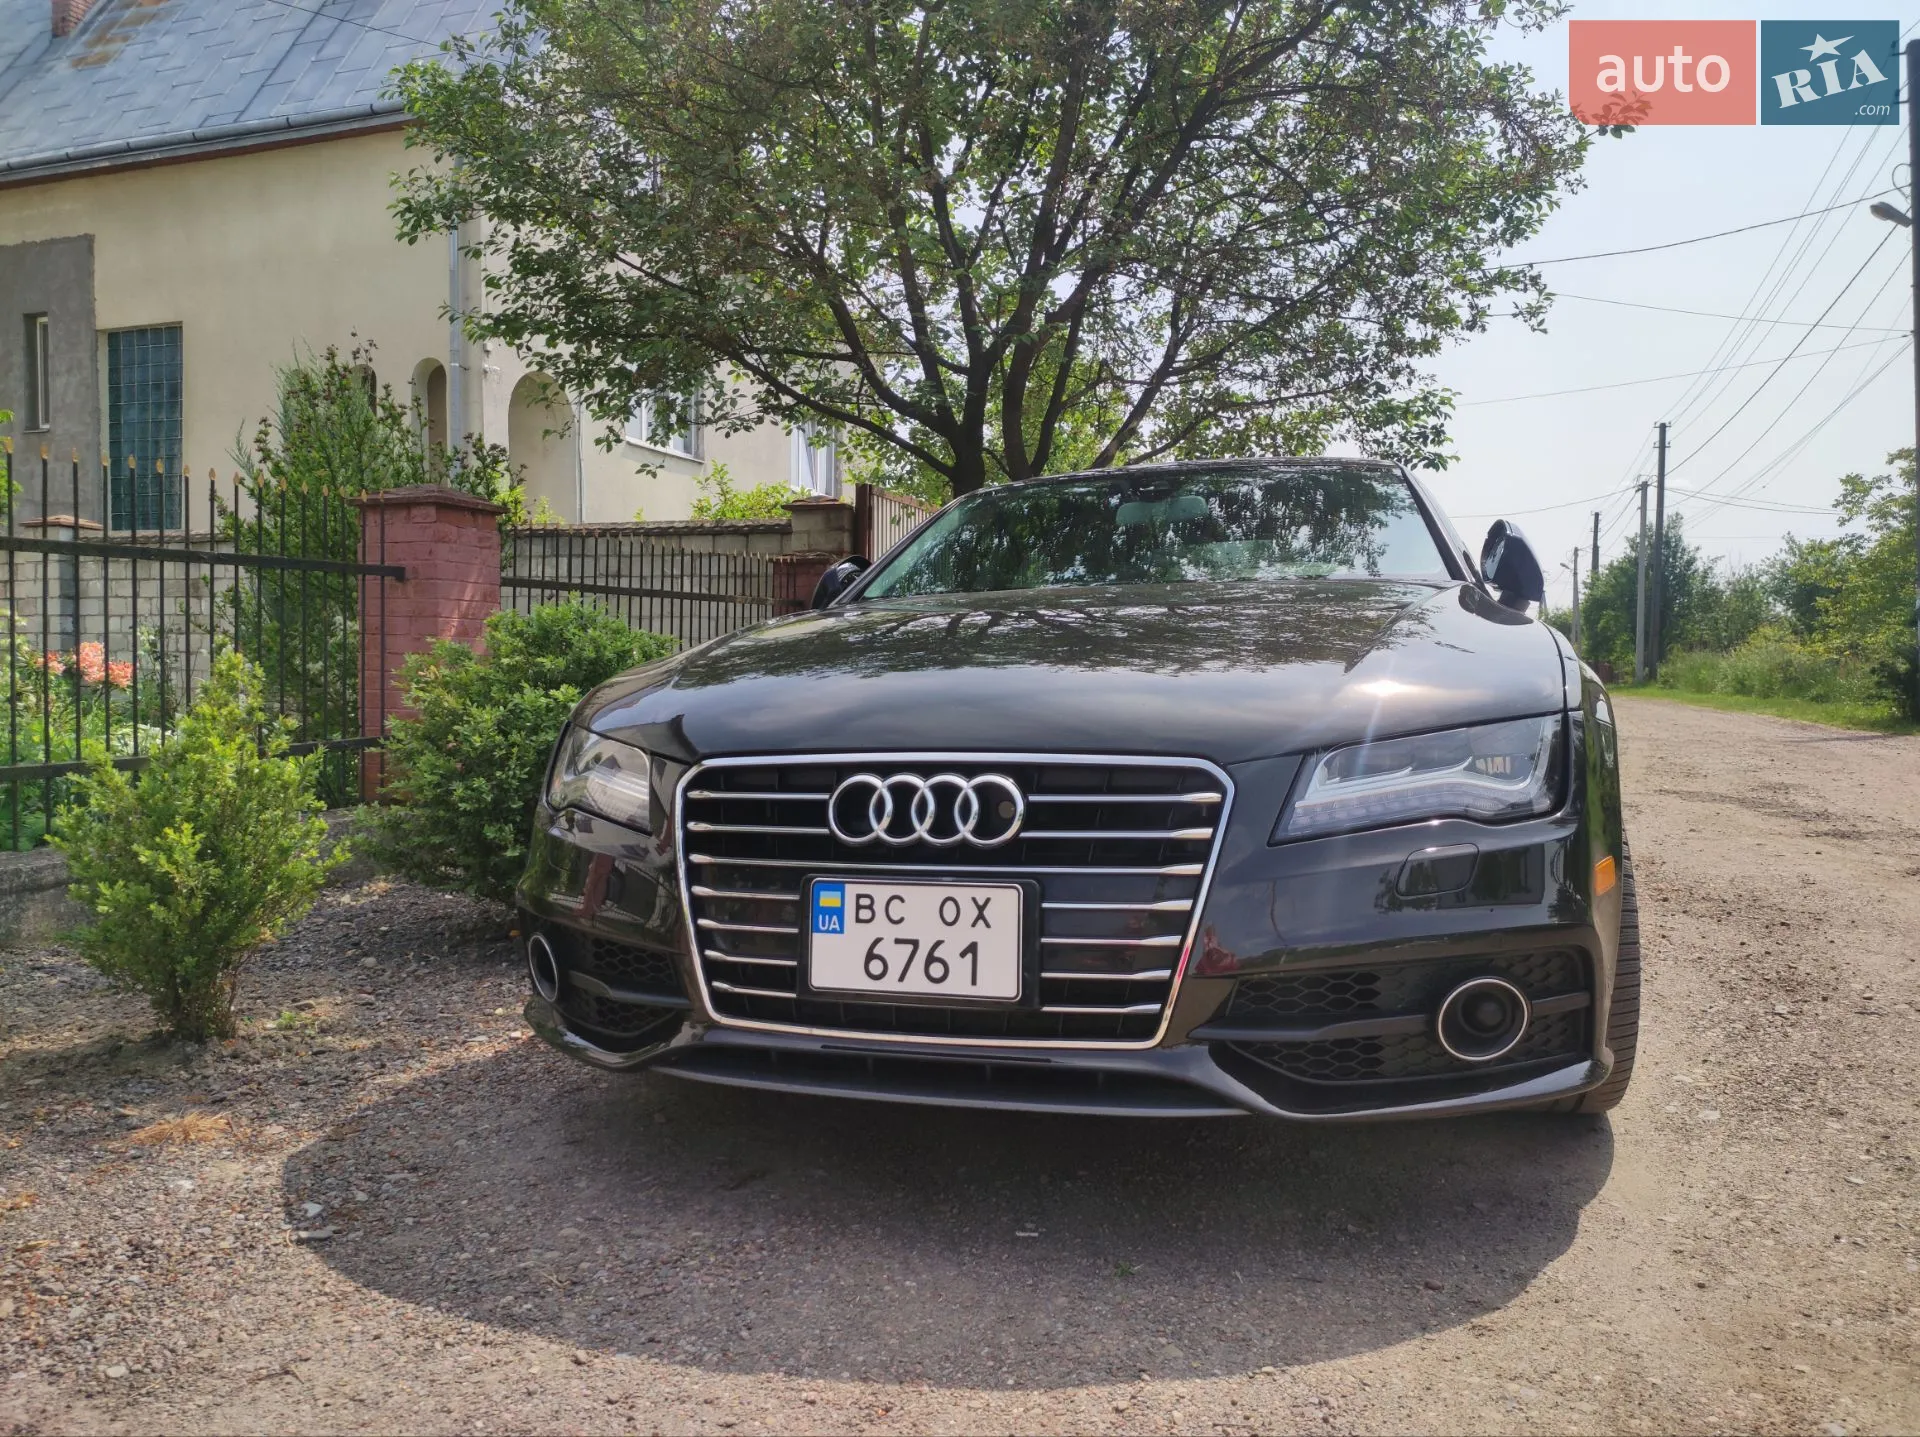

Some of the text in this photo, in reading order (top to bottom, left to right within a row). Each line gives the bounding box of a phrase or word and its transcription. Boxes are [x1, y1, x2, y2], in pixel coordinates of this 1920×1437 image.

[818, 914, 841, 931] UA
[855, 893, 991, 928] BC OX
[863, 936, 979, 987] 6761
